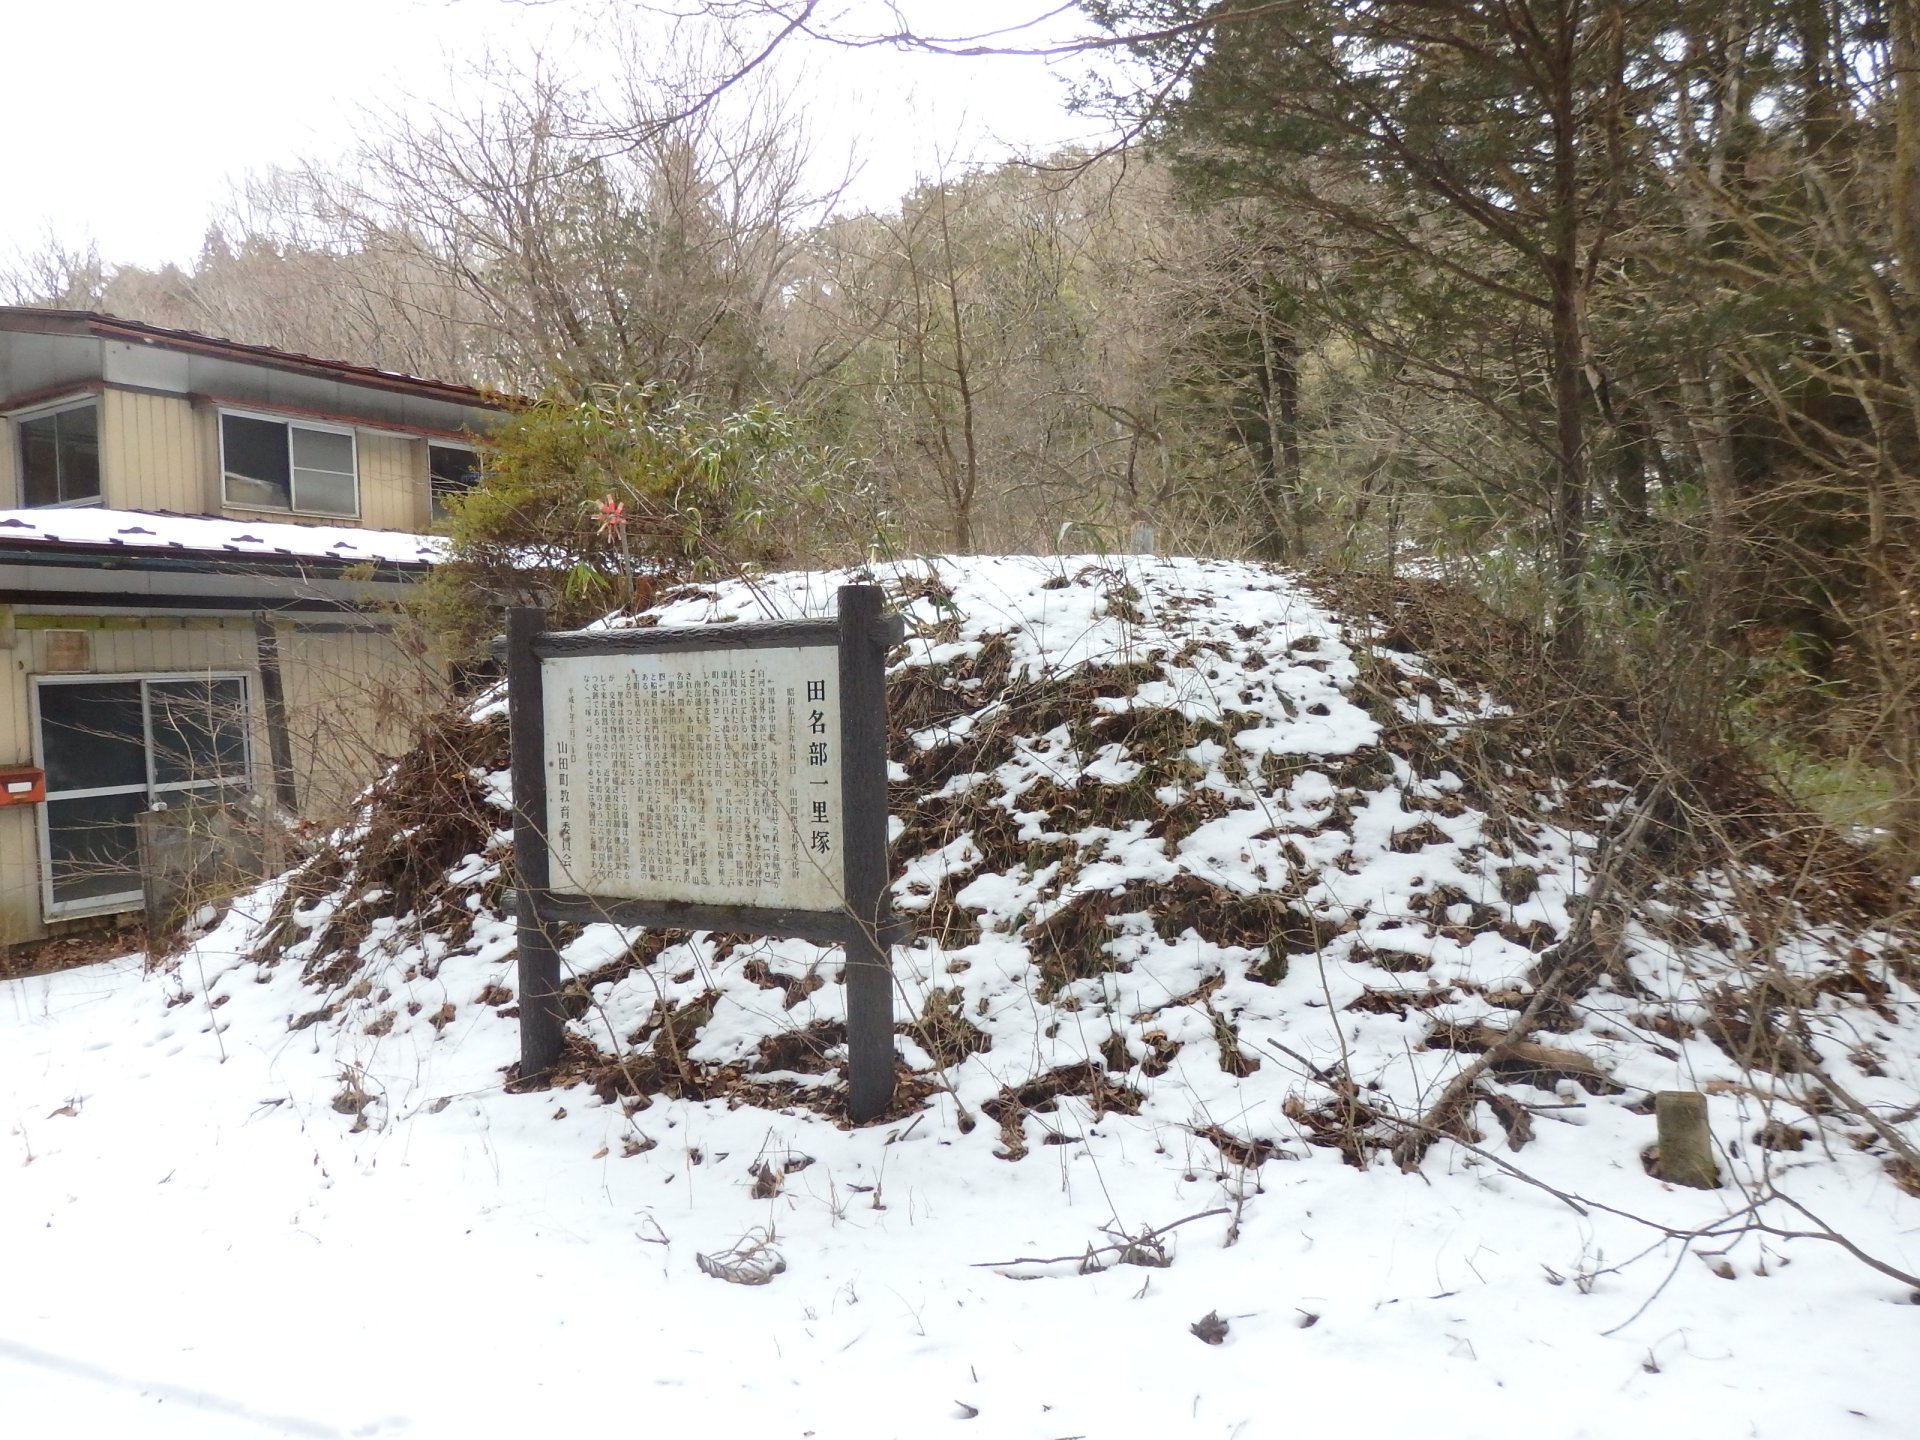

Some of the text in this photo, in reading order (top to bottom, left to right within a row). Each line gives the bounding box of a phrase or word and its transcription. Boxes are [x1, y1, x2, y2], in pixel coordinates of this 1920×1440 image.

[556, 740, 572, 868] 山田町教育委員会
[805, 679, 830, 855] 田名部一里塚
